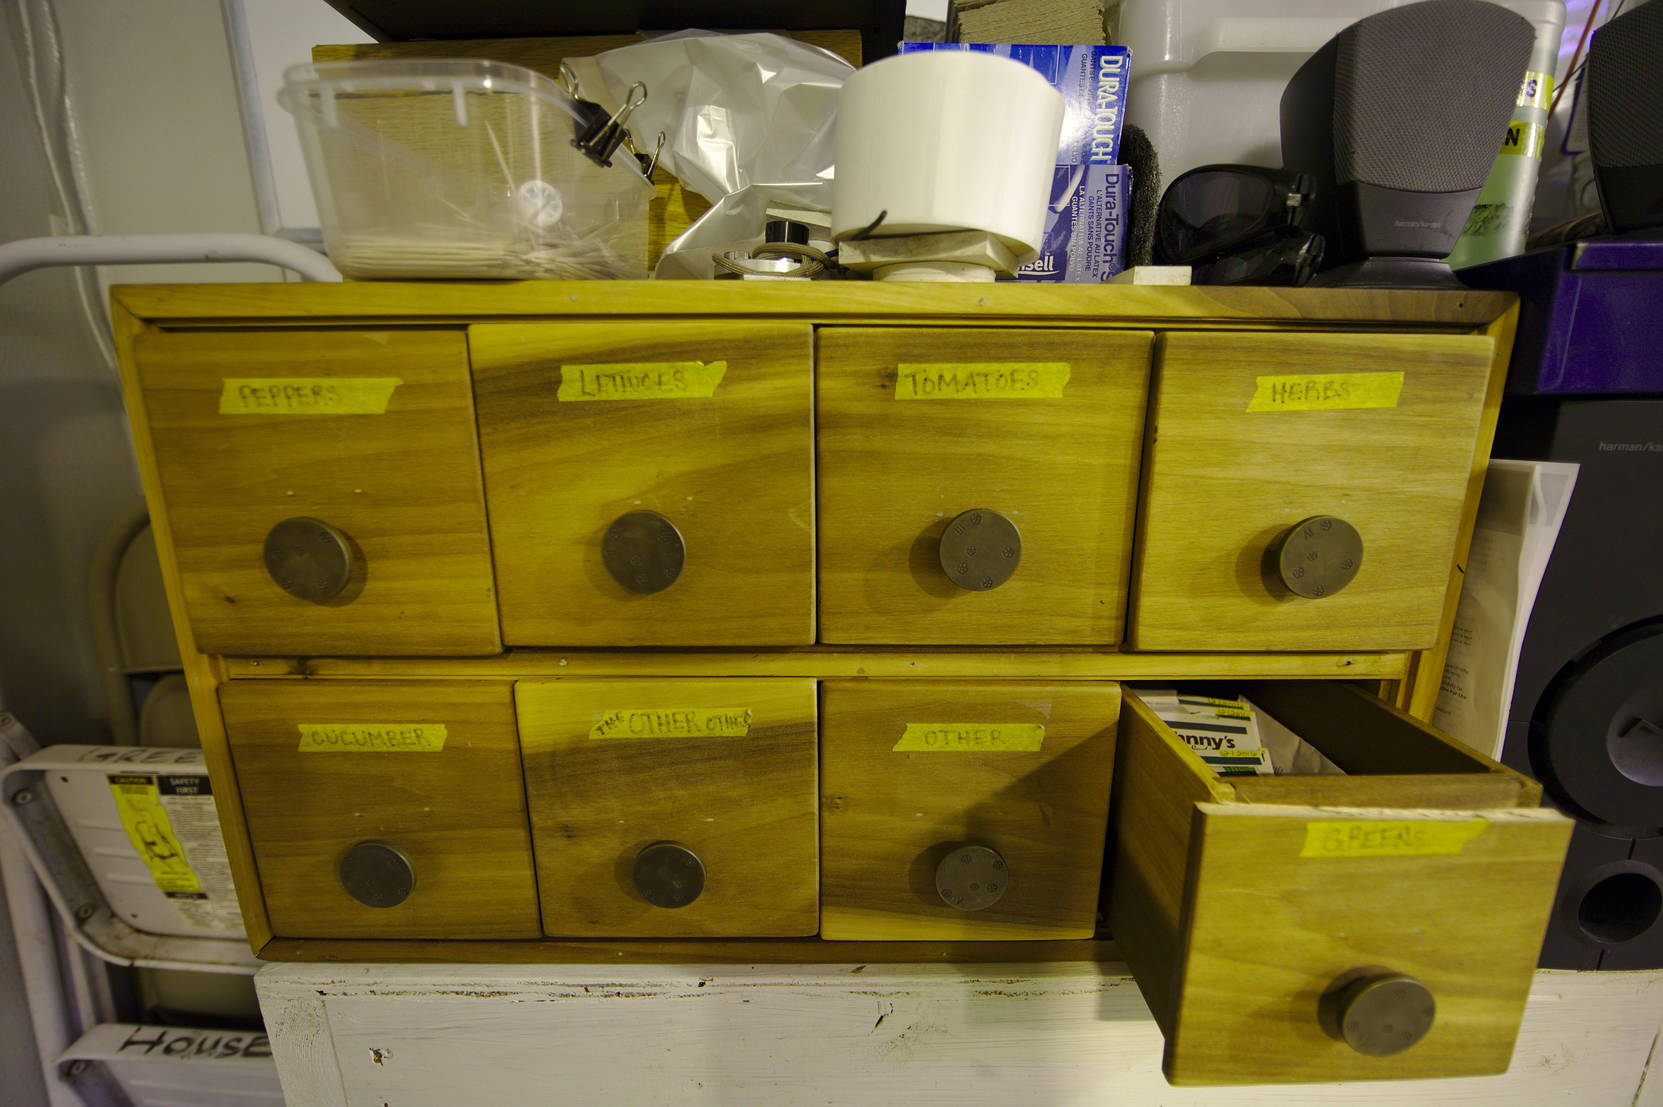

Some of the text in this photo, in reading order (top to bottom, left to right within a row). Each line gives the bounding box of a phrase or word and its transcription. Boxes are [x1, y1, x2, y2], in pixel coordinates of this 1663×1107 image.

[1090, 55, 1124, 161] DURA-TOUCH
[1071, 195, 1079, 231] GUANTES
[1087, 220, 1095, 241] SANS
[1085, 241, 1094, 272] POUDRE
[1094, 243, 1101, 254] AU
[1091, 255, 1101, 279] LATEX
[903, 369, 1039, 396] TOMATOES
[1271, 380, 1351, 404] HERBS
[239, 384, 342, 408] PEPPERS
[628, 710, 701, 735] OTHER
[311, 728, 432, 747] CUCUMBER
[924, 729, 1006, 746] OTHER
[77, 747, 202, 764] GREE
[115, 1026, 273, 1059] HOUSE
